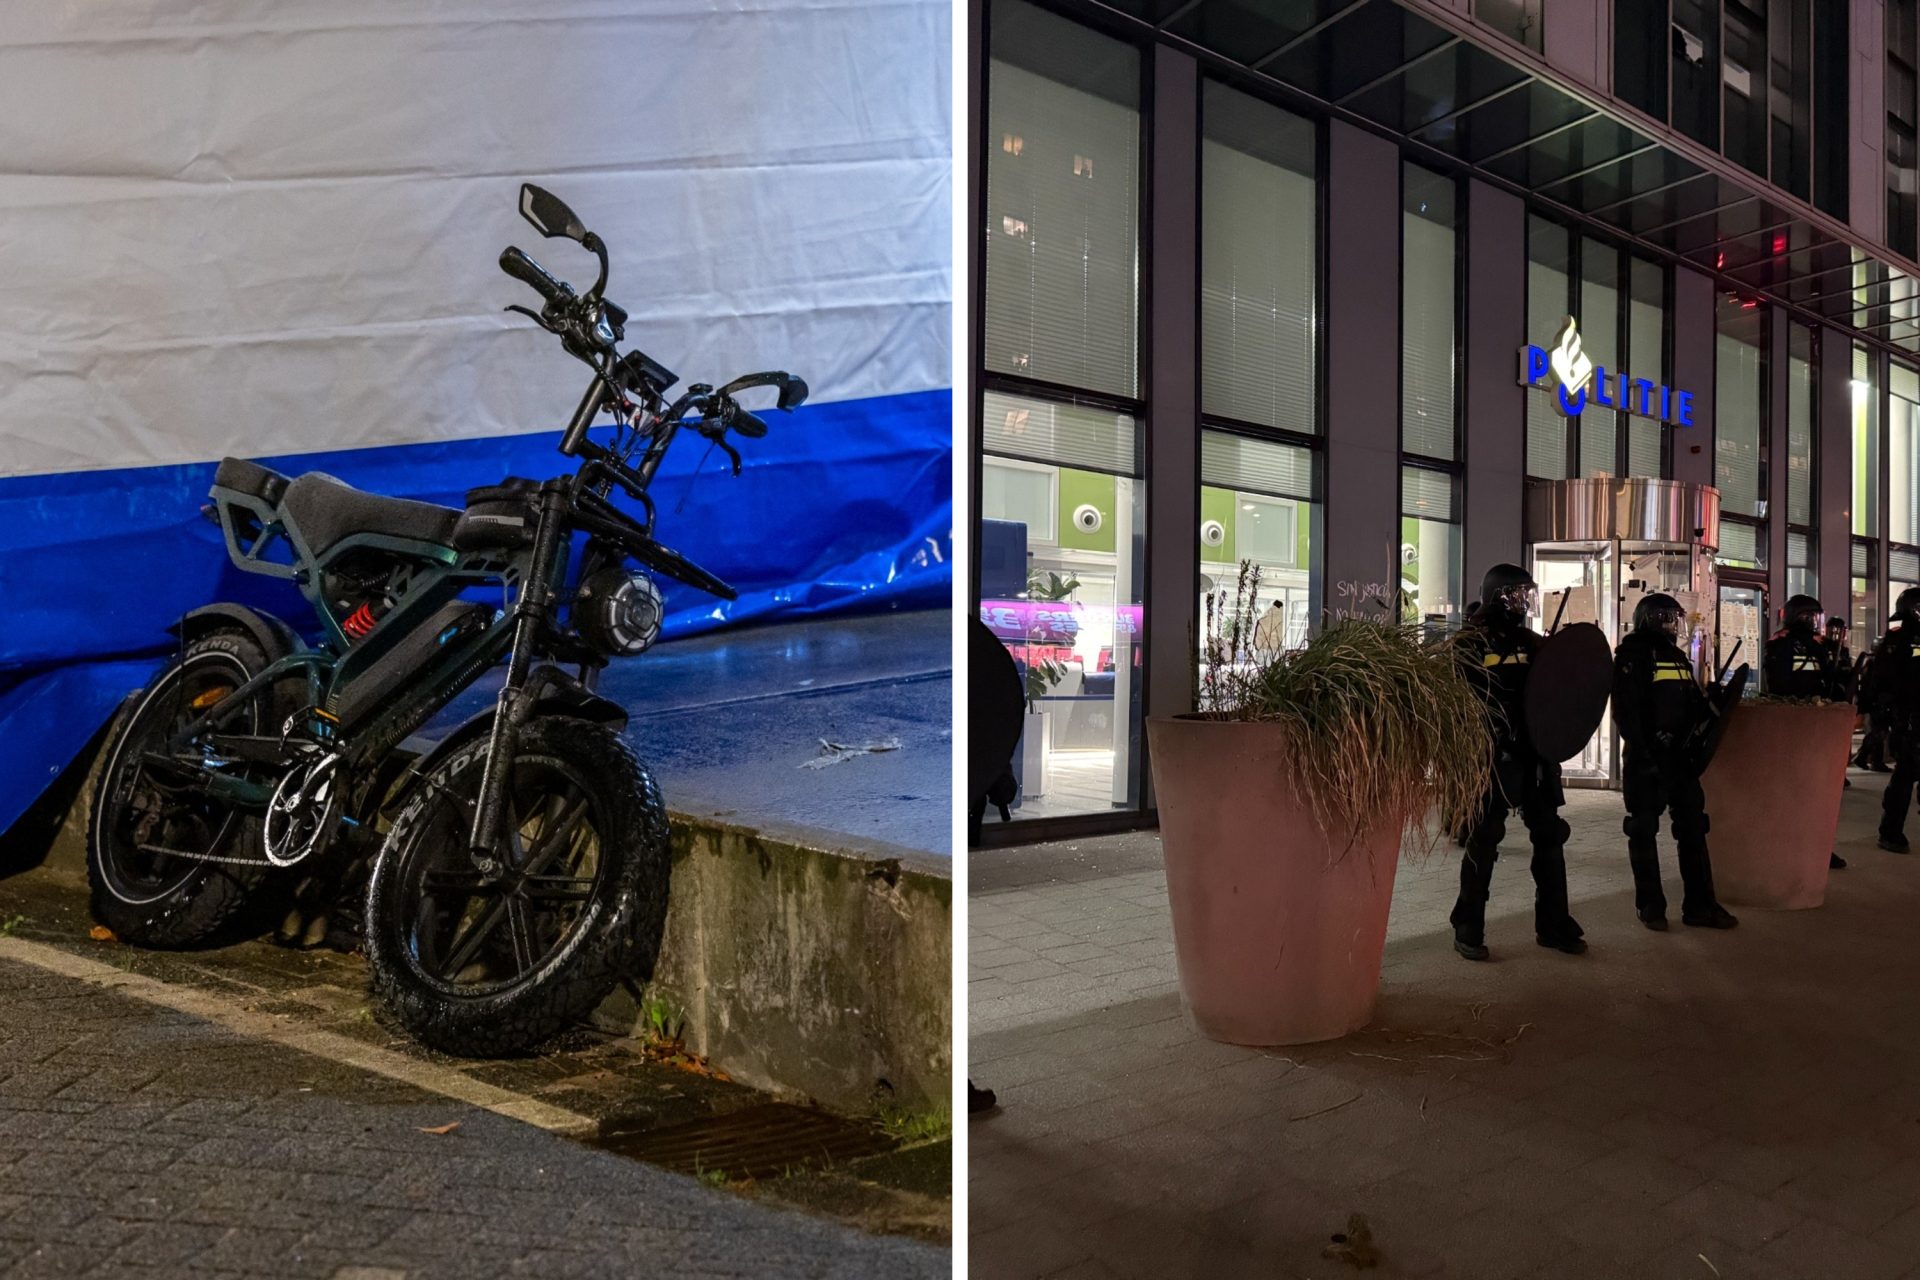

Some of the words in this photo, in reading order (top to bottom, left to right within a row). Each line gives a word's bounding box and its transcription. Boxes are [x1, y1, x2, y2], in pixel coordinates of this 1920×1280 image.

[1525, 344, 1694, 428] POLITIE
[185, 640, 239, 658] KENDA
[386, 743, 491, 853] KENDA
